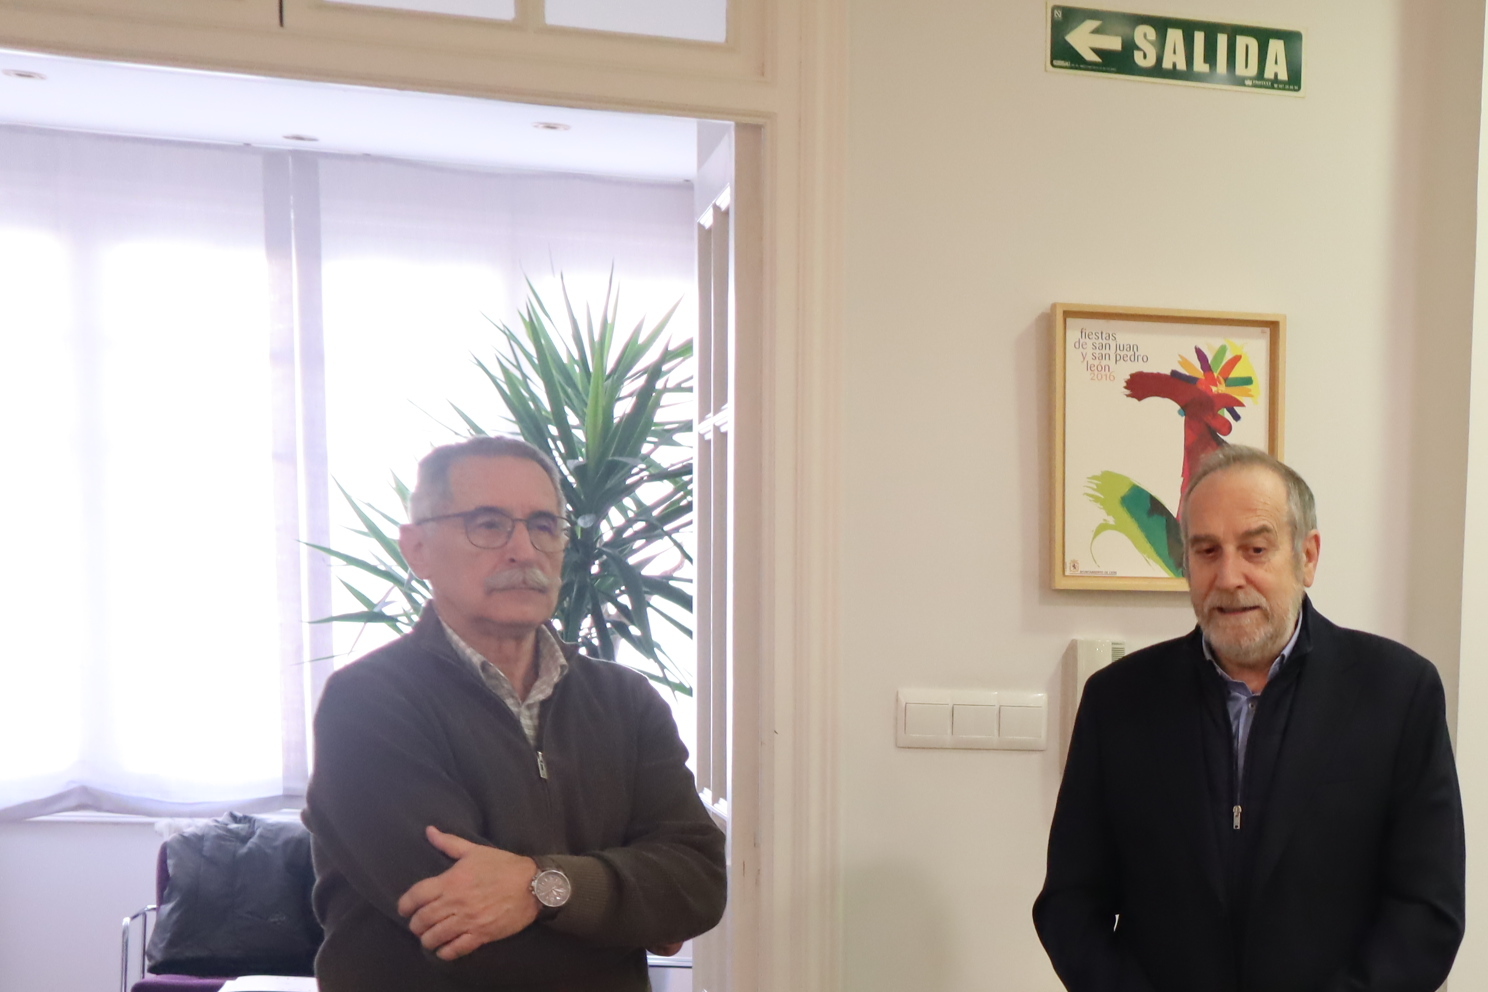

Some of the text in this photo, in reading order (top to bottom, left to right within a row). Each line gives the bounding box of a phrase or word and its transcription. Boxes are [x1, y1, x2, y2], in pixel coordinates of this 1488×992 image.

[1133, 24, 1289, 81] SALIDA
[1080, 328, 1117, 341] fiestas
[1074, 338, 1139, 354] de san juan
[1081, 351, 1149, 365] y san pedro
[1086, 360, 1111, 373] león
[1090, 371, 1116, 382] 2016
